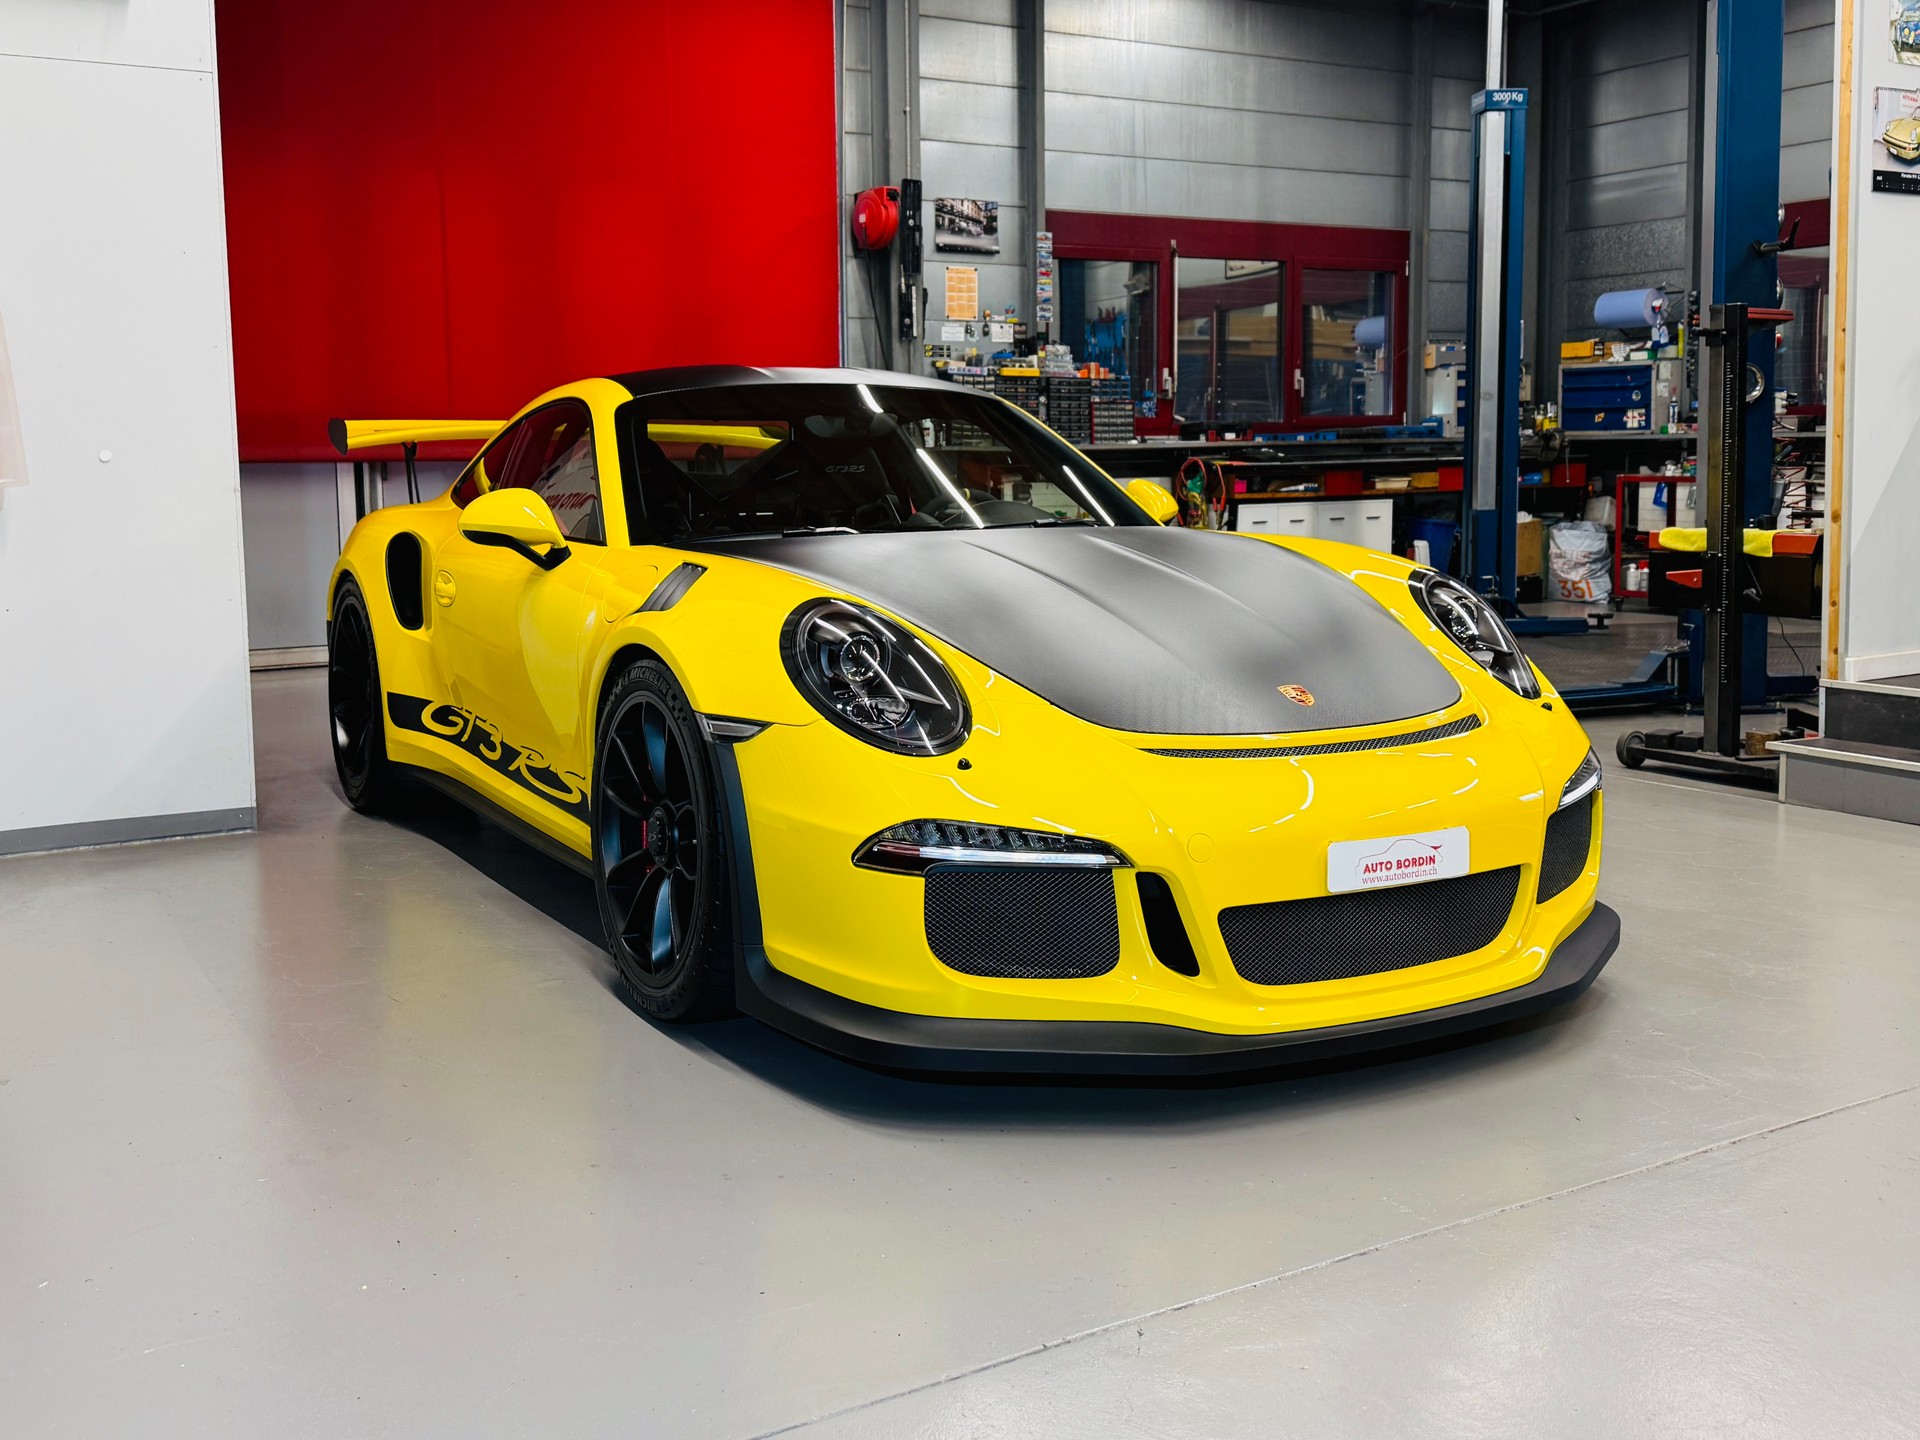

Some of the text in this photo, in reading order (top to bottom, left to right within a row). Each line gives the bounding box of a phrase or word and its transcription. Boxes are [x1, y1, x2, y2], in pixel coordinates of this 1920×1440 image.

[1492, 91, 1523, 102] 3000 Kg
[629, 667, 671, 696] MICHELIN
[421, 700, 590, 804] GT3 RS
[1362, 866, 1438, 884] www.autobordin.ch
[1363, 855, 1436, 875] AUTO BORDIN
